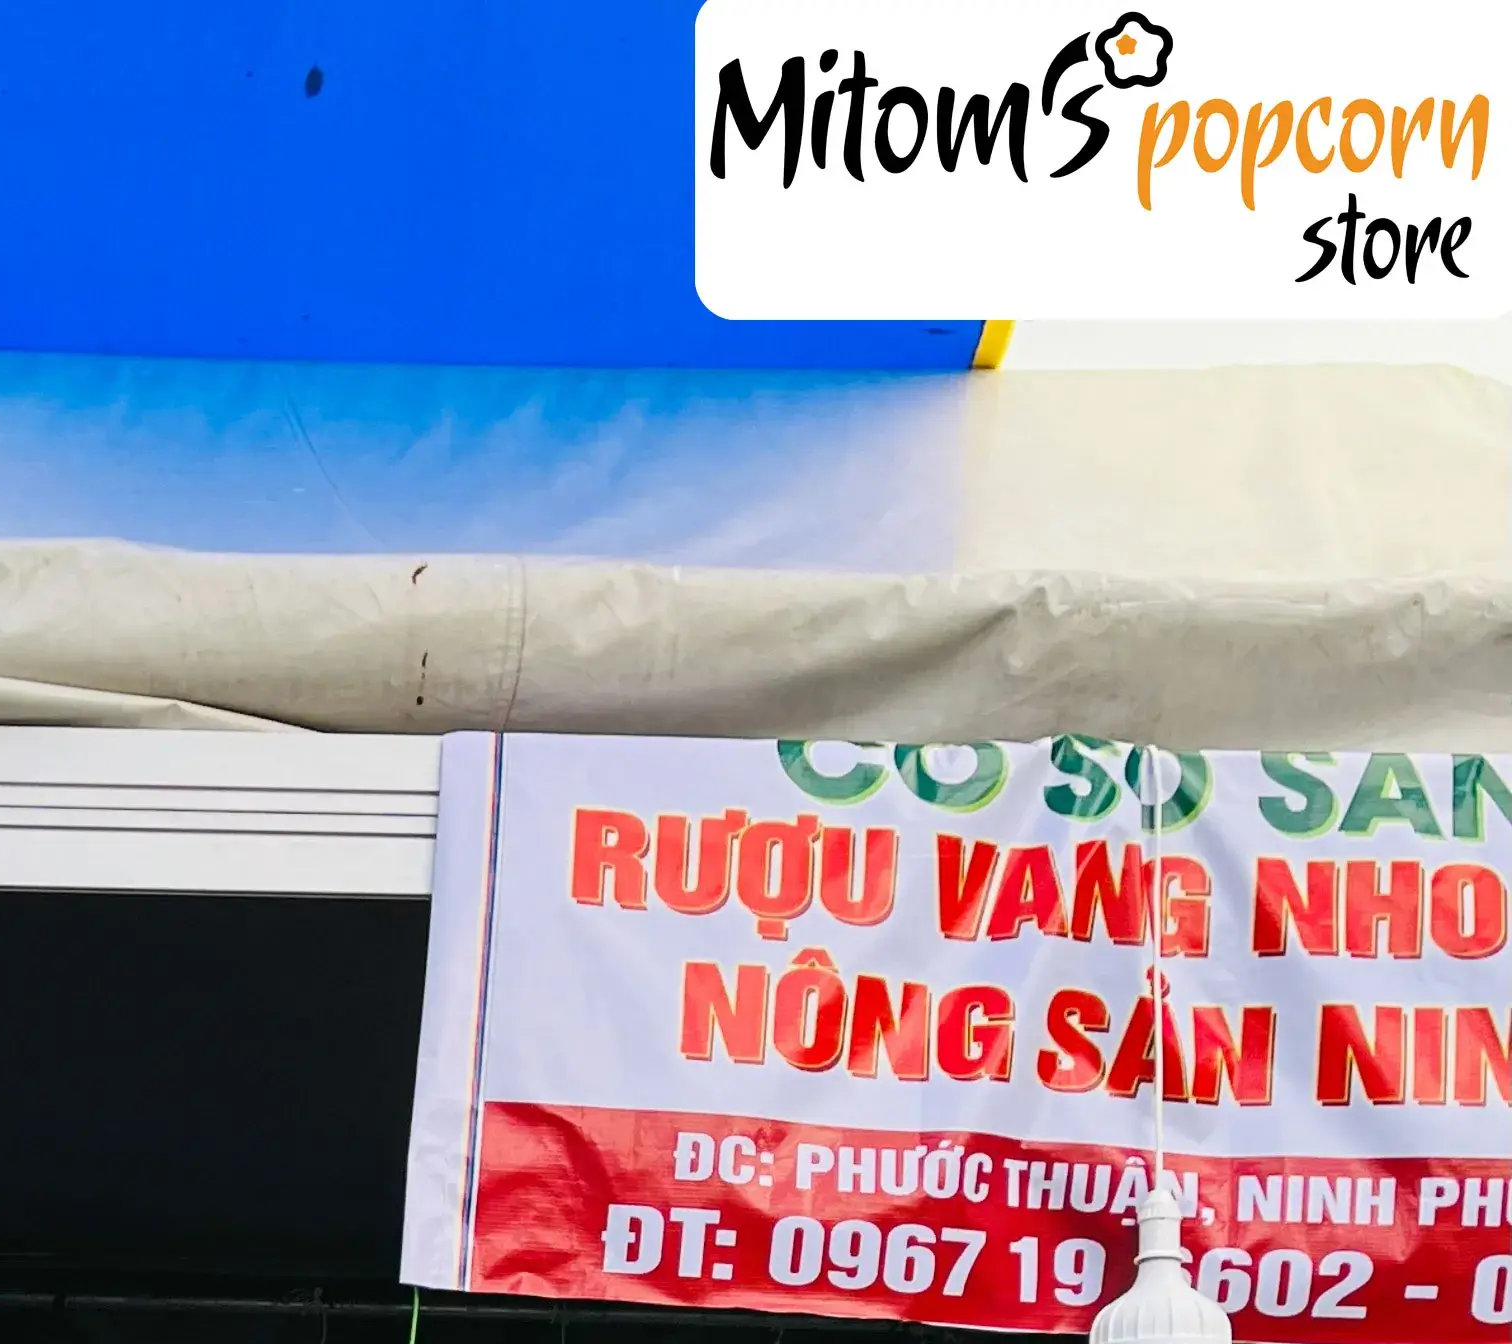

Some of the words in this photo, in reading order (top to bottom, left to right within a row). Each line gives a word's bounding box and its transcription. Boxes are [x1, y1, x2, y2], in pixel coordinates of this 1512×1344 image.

[572, 809, 899, 940] RƯỢU
[936, 834, 1210, 959] VANG
[1252, 856, 1507, 959] NHO
[680, 947, 1015, 1083] NÔNG
[1037, 965, 1276, 1107] SẢN
[673, 1132, 774, 1187] ĐC:
[796, 1140, 992, 1202] PHƯỚC
[1237, 1174, 1396, 1226] NINH
[1418, 1177, 1512, 1227] PH
[601, 1204, 737, 1281] ĐT:
[768, 1216, 986, 1296] 0967
[1010, 1236, 1106, 1307] 19
[1180, 1246, 1373, 1319] 602
